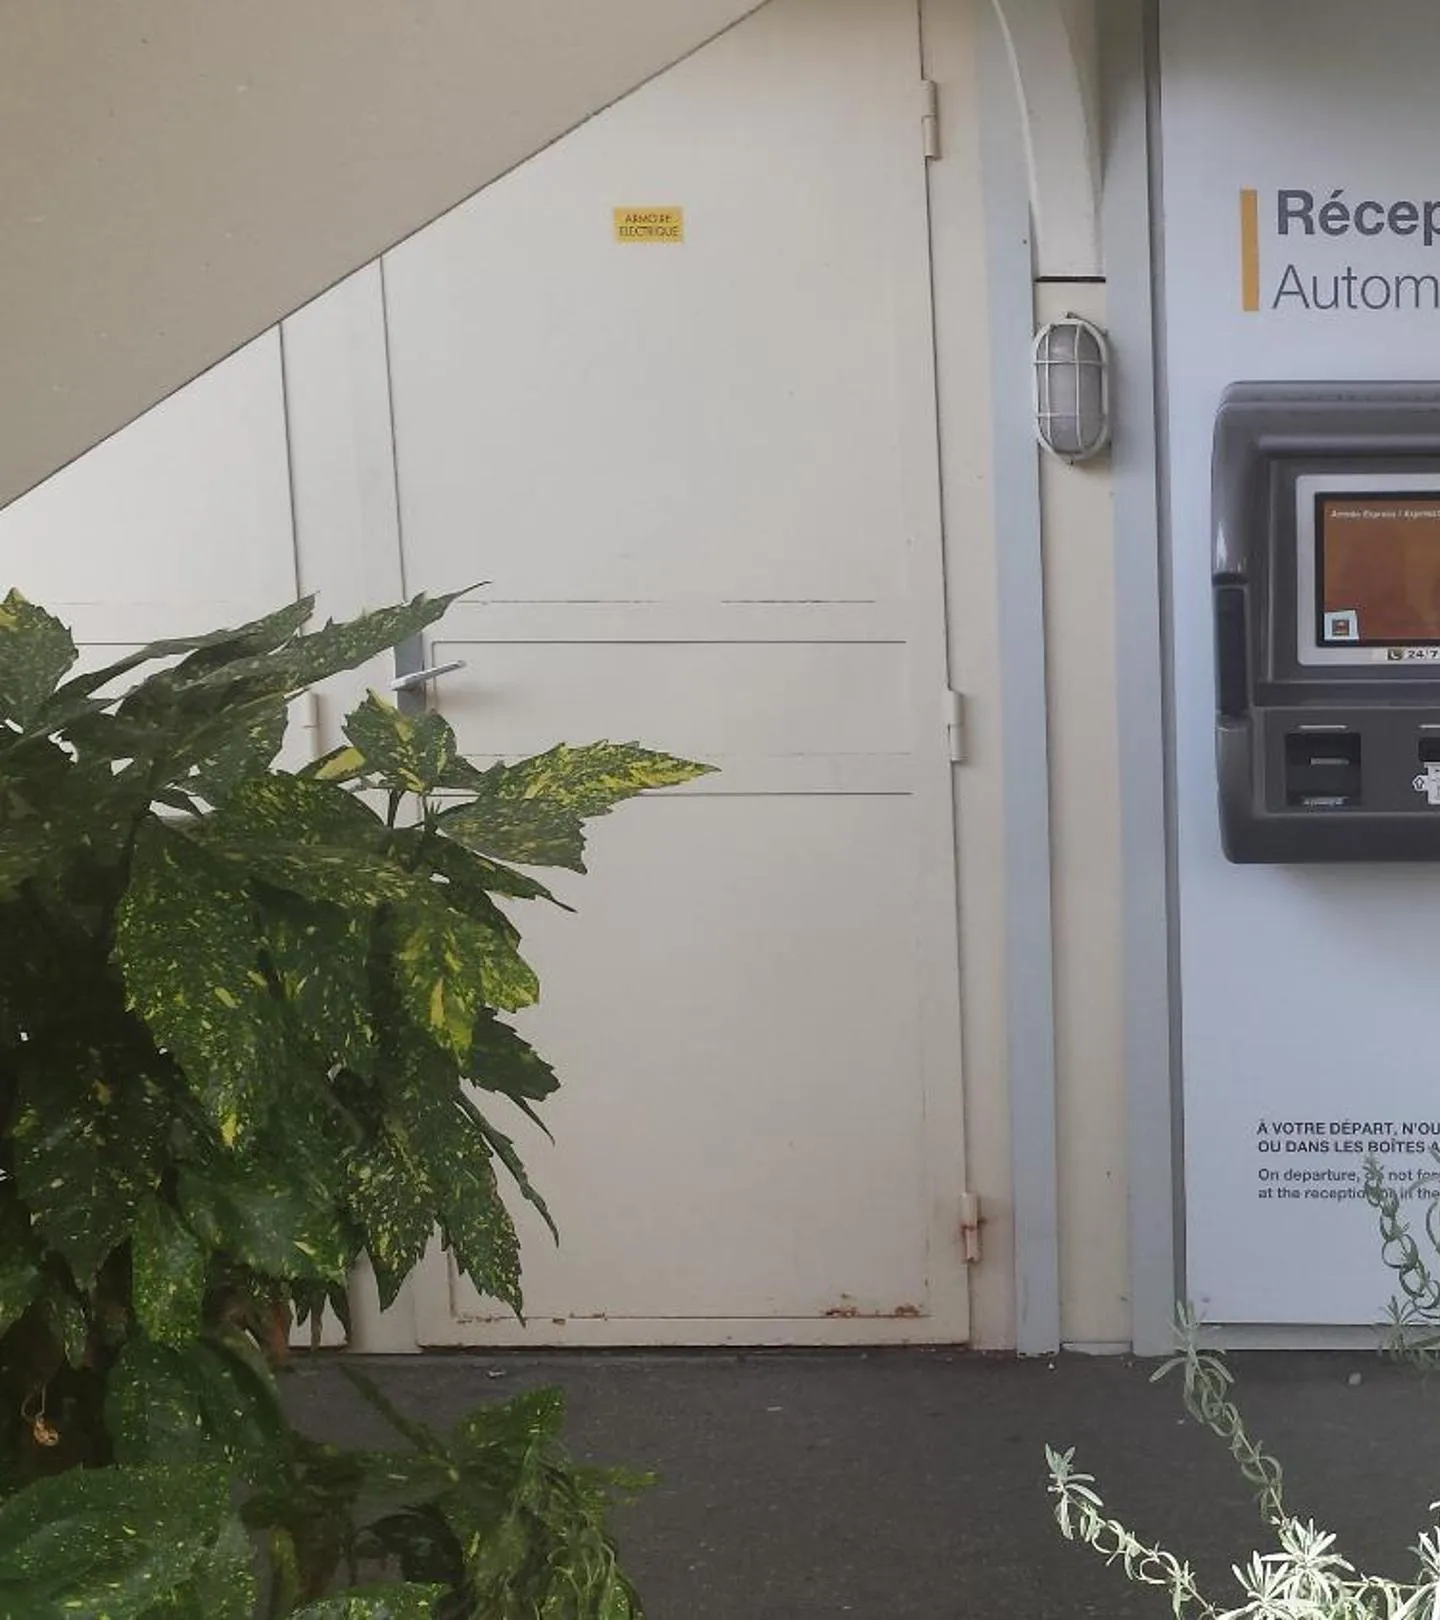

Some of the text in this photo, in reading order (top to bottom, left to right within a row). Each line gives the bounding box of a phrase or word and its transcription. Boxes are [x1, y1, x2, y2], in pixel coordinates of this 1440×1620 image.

[1256, 1119, 1268, 1135] À
[1273, 1122, 1326, 1135] VOTRE
[1330, 1119, 1398, 1137] DÉPART,
[1258, 1141, 1281, 1153] OU
[1286, 1141, 1329, 1153] DANS
[1334, 1141, 1363, 1153] LES
[1369, 1138, 1424, 1153] BOÎTES
[1258, 1169, 1279, 1181] On
[1284, 1169, 1361, 1185] departure,
[1389, 1169, 1412, 1181] not
[1258, 1188, 1274, 1199] at
[1278, 1188, 1300, 1199] the
[1304, 1188, 1375, 1202] receptio
[1417, 1188, 1440, 1199] the
